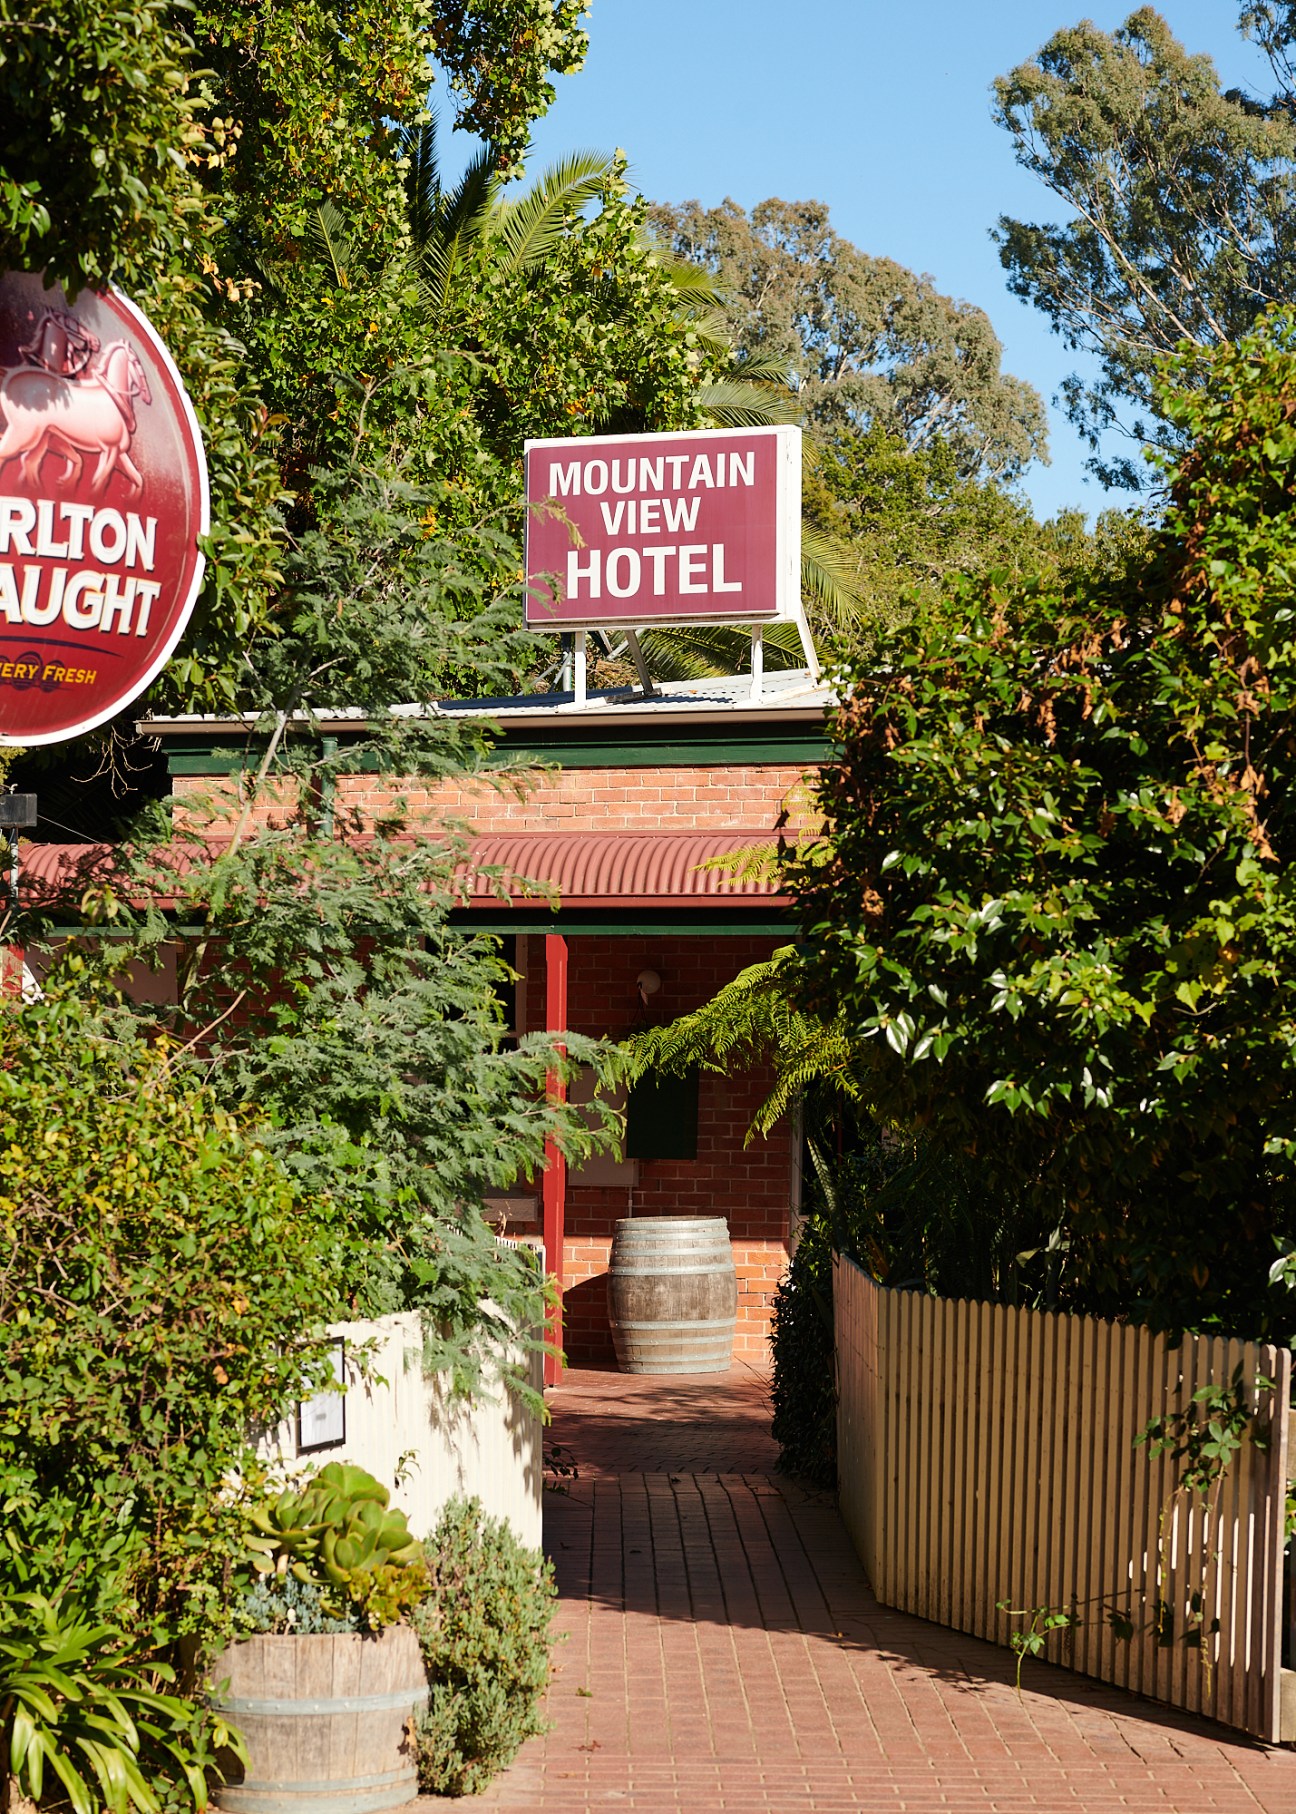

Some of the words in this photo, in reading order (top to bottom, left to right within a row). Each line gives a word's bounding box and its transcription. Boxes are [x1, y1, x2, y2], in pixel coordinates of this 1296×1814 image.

[549, 451, 755, 497] MOUNTAIN
[600, 496, 701, 536] VIEW
[567, 543, 743, 599] HOTEL
[42, 665, 97, 684] FRESH
